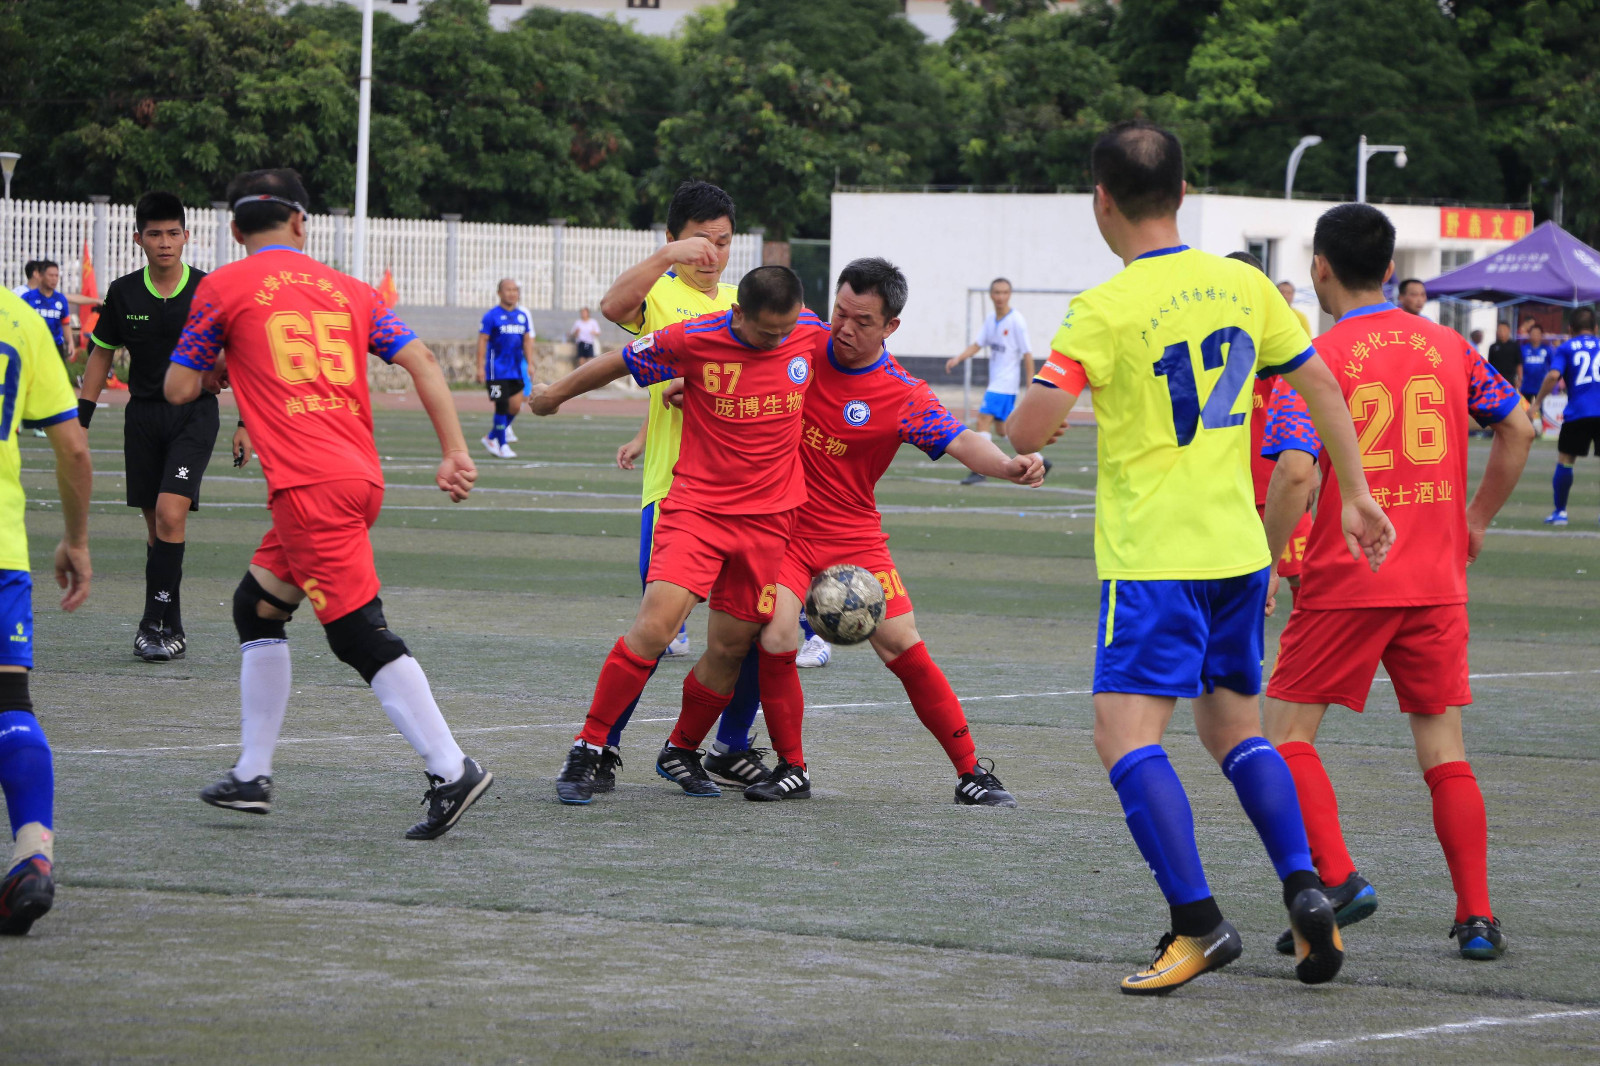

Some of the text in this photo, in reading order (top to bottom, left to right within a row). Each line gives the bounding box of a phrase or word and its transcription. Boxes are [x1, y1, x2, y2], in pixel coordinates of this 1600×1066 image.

[254, 271, 349, 307] 化学化工学院
[677, 308, 701, 317] KELM
[265, 310, 357, 385] 65
[1344, 330, 1443, 380] 化学化工学院
[490, 385, 502, 398] 75
[703, 361, 742, 394] 67
[1152, 326, 1256, 447] 12
[285, 391, 361, 416] 尚武士业
[801, 419, 848, 457] 生物
[1348, 373, 1448, 472] 26
[1371, 480, 1452, 509] 武士酒业
